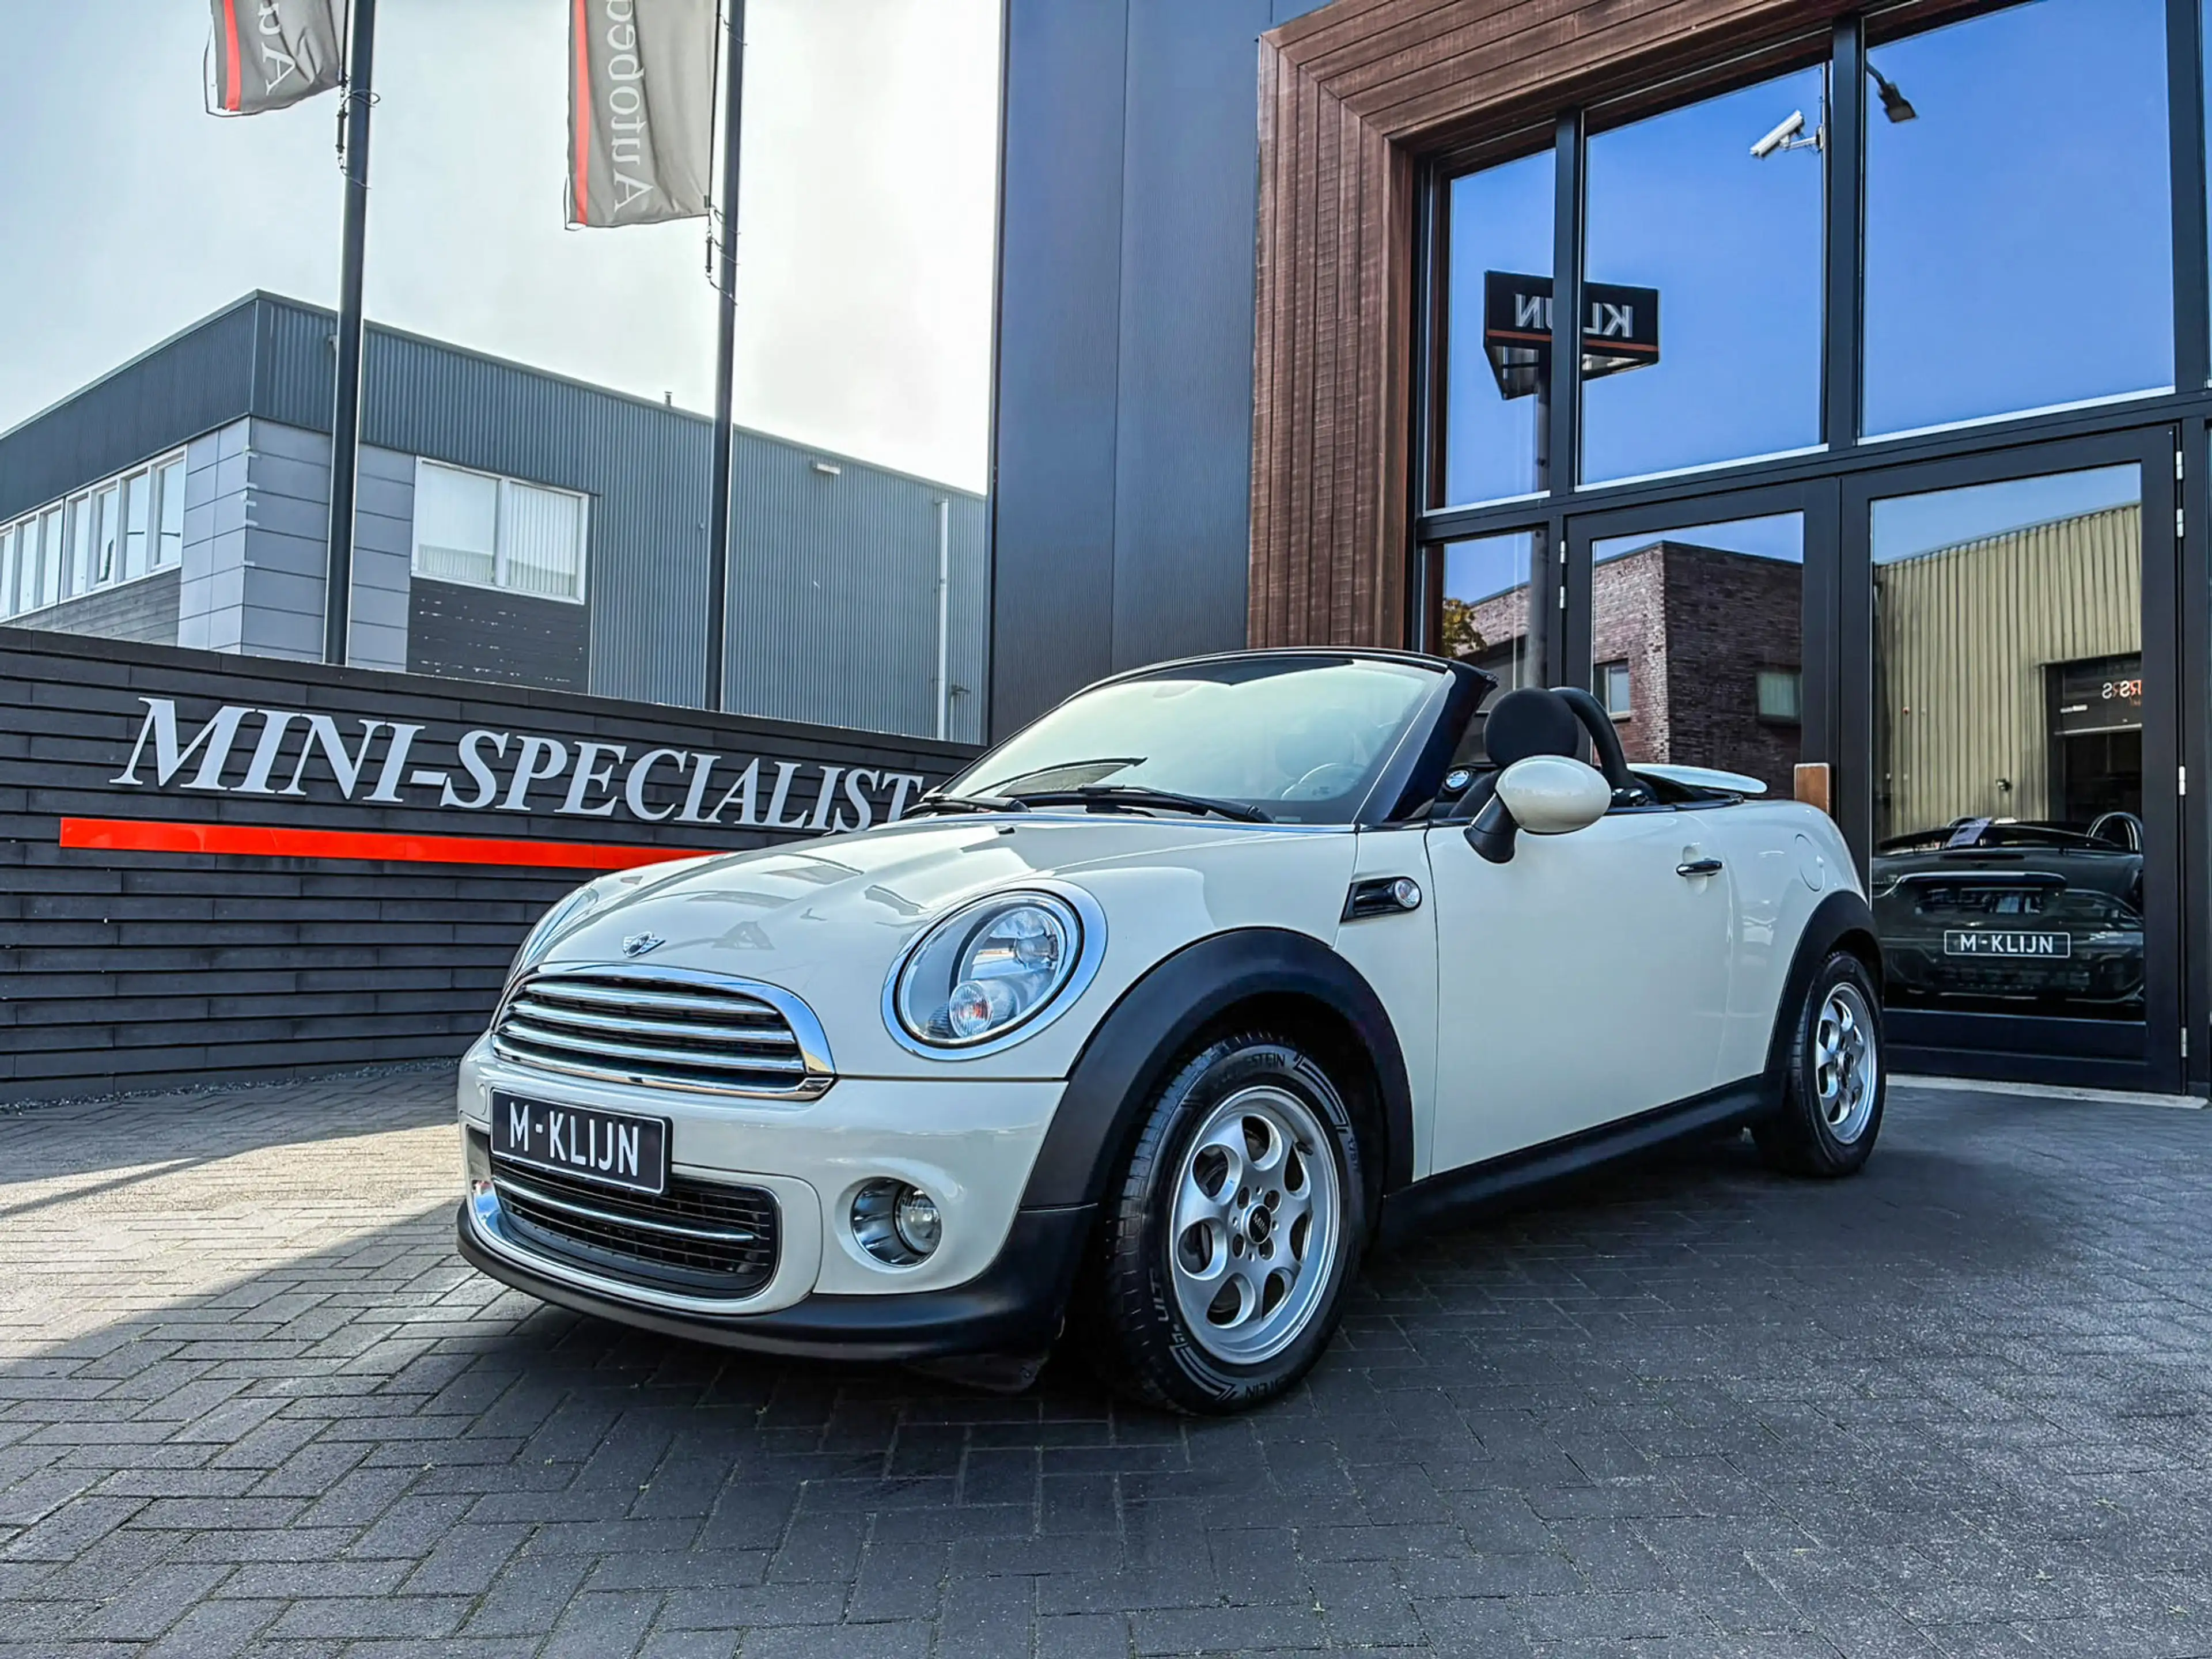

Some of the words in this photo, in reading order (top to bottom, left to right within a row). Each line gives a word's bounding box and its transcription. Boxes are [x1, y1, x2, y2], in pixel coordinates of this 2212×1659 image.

[109, 696, 924, 833] MINI-SPECIALIST
[1960, 933, 2054, 955] M-KLIJN
[510, 1101, 639, 1176] M-KLIJN
